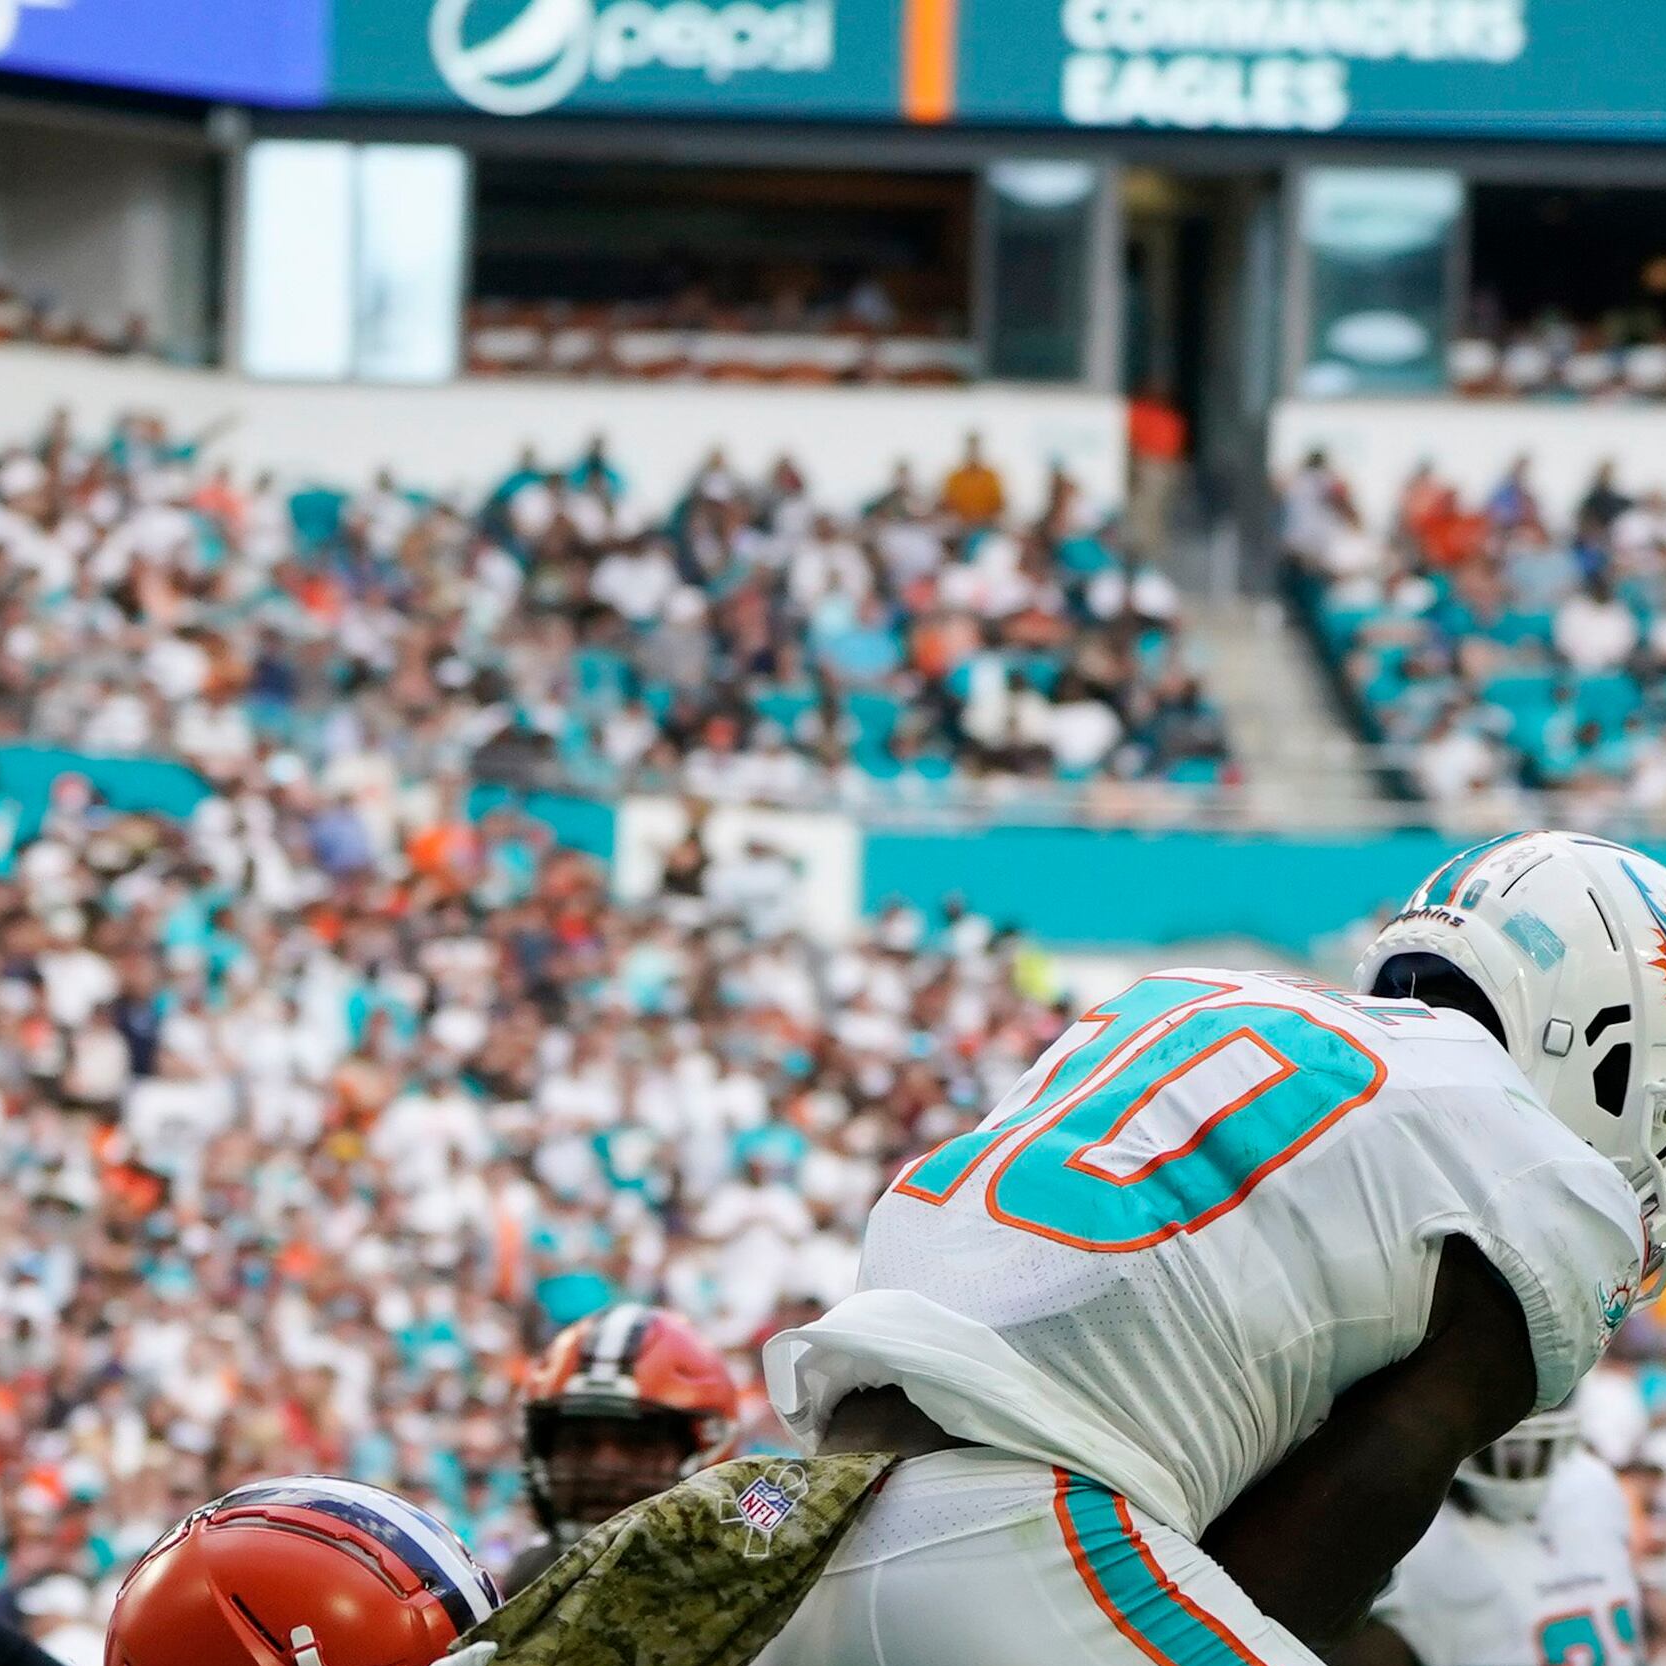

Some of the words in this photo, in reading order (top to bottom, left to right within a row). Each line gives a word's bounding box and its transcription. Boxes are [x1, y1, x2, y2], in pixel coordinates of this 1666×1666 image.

[590, 0, 834, 82] pepsi
[1063, 0, 1526, 62] COMMANDERS
[1063, 52, 1349, 130] EAGLES
[892, 975, 1388, 1253] 10
[740, 1496, 777, 1528] NFL
